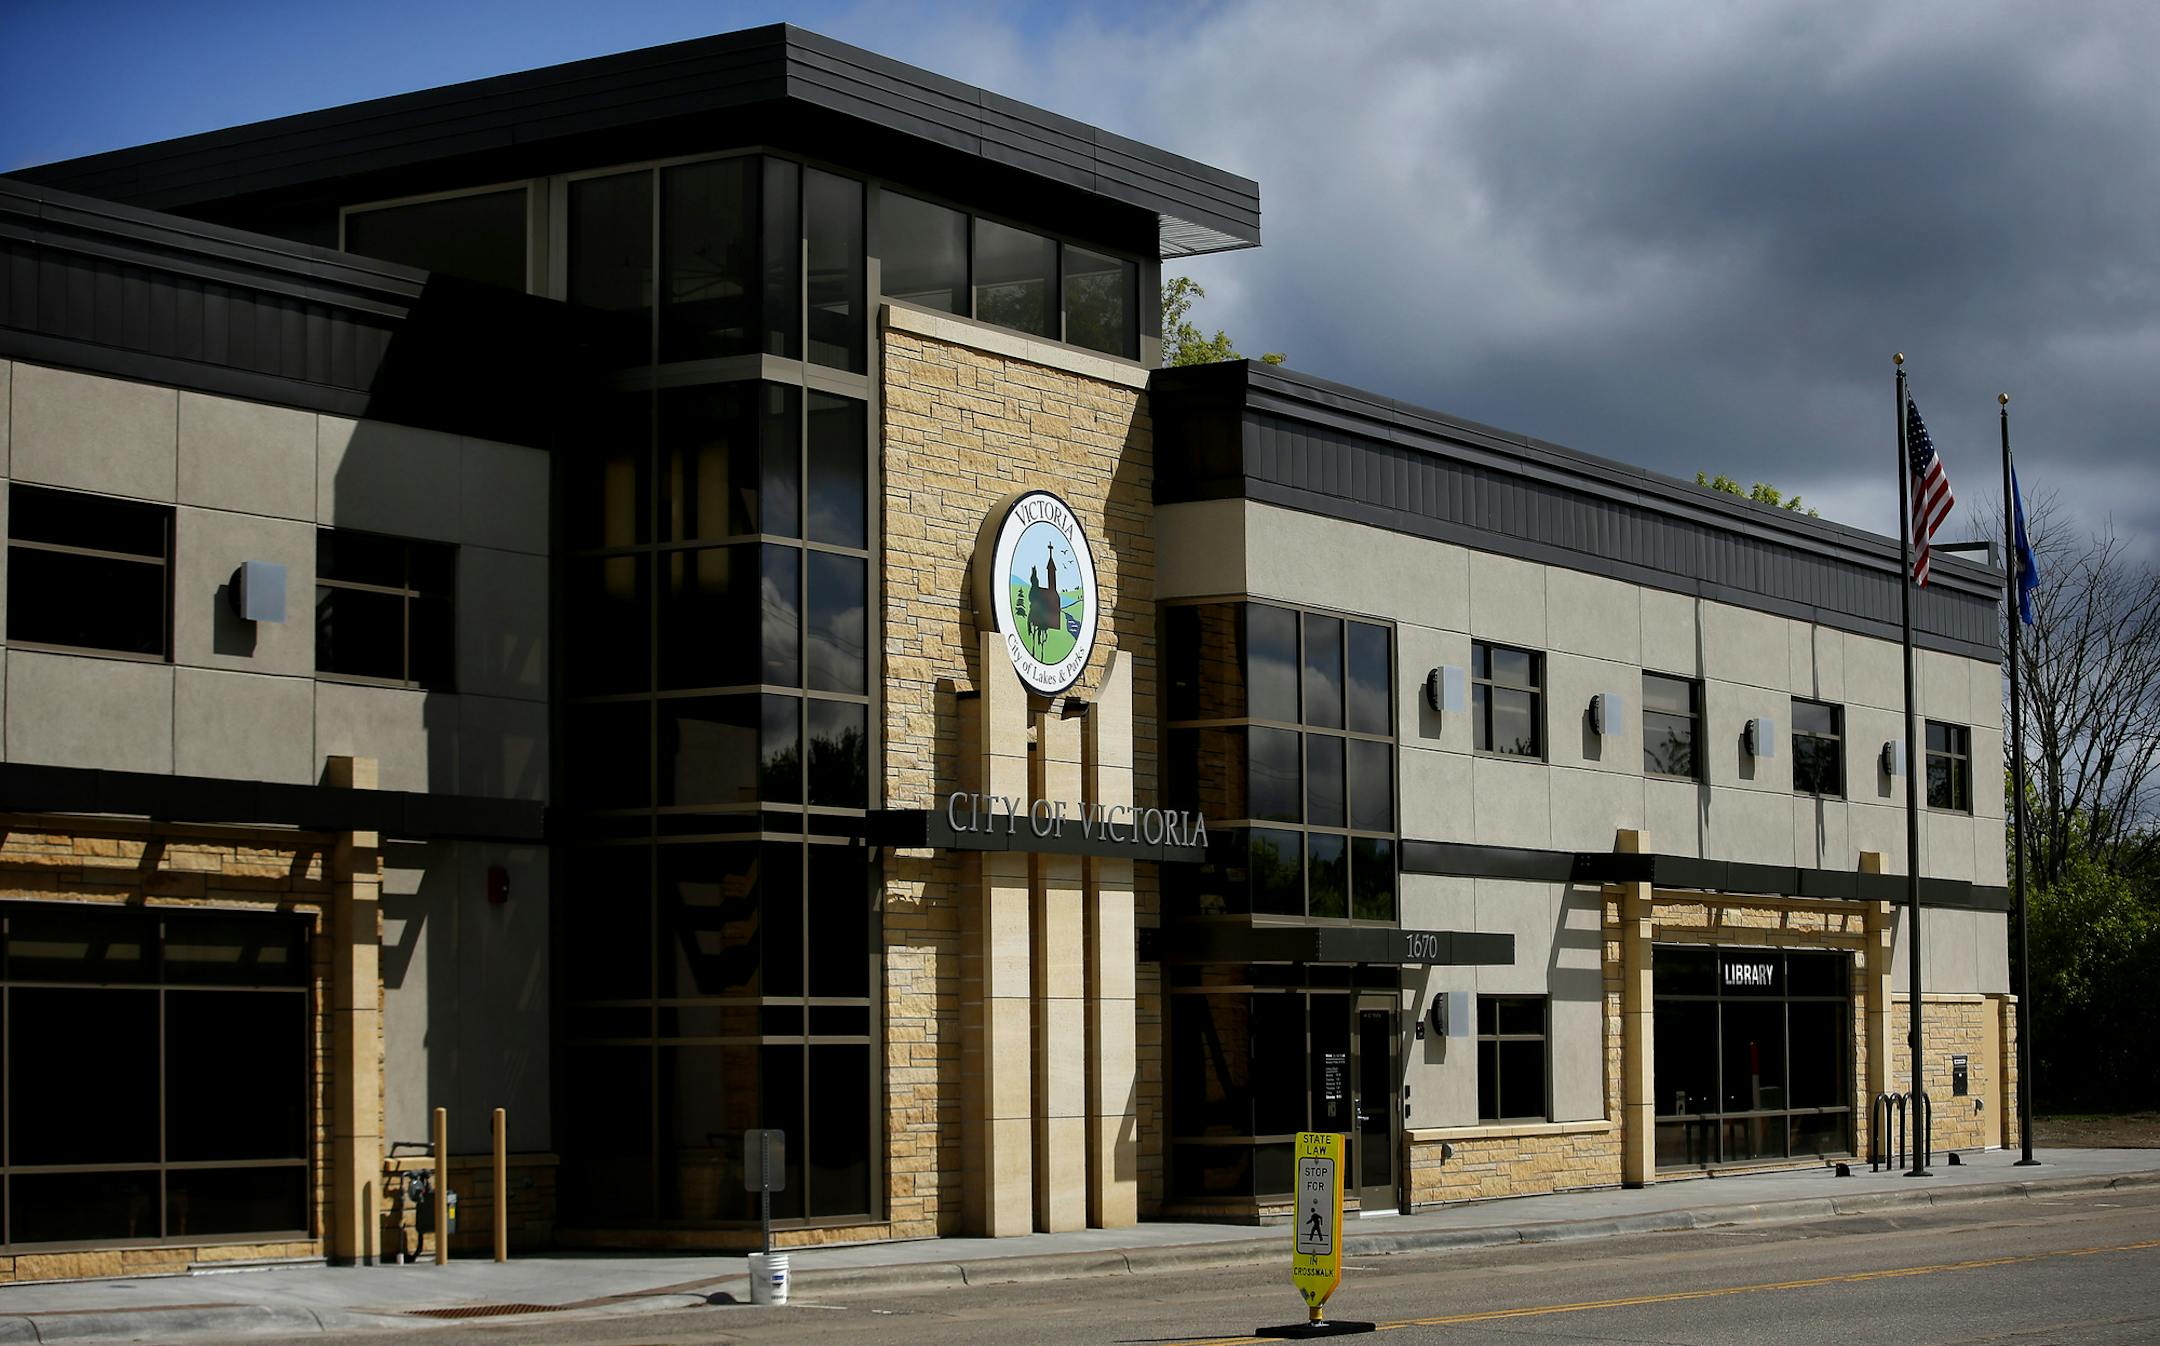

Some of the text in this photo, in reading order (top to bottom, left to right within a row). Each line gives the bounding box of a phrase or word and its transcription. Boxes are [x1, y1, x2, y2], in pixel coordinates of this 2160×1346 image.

[1015, 501, 1073, 540] VICTORIA
[1008, 633, 1085, 685] City of Lakes & Parks
[948, 791, 1209, 848] CITY OF VICTORIA
[1406, 933, 1438, 959] 1670
[1725, 963, 1774, 986] LIBRARY
[1303, 1134, 1331, 1145] STATE
[1307, 1146, 1327, 1155] LAW
[1305, 1167, 1328, 1177] STOP
[1307, 1181, 1325, 1191] FOR
[1309, 1257, 1318, 1265] IN
[1293, 1267, 1334, 1277] CROSSWALK
